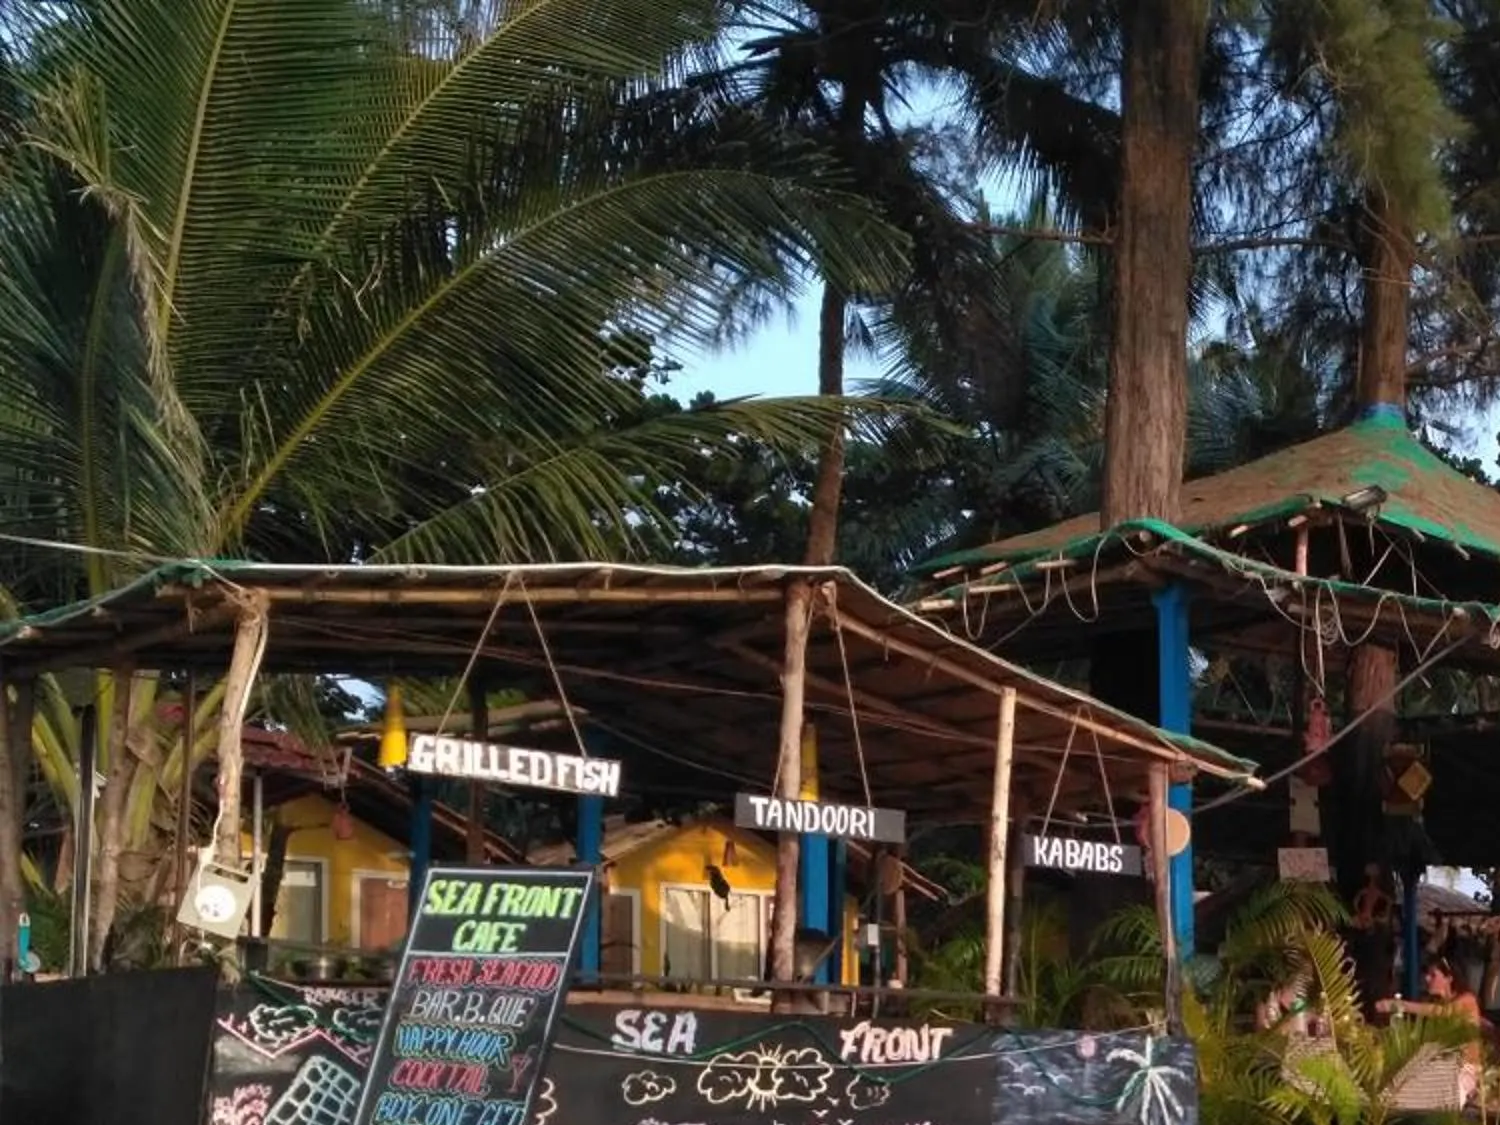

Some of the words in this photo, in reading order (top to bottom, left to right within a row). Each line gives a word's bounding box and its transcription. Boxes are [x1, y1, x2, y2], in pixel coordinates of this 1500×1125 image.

[408, 735, 552, 786] GRILLED
[556, 754, 621, 796] FISH
[748, 796, 875, 838] TANDOORI
[1033, 836, 1123, 873] KABABS
[422, 879, 483, 915] SEA
[480, 882, 583, 919] FRONT
[452, 919, 528, 952] CAFE
[408, 958, 474, 986] FRESH
[398, 1024, 458, 1053] HAPPY
[458, 1029, 510, 1066] HOUR
[612, 1008, 697, 1054] SEA
[840, 1020, 953, 1063] FRONT
[375, 1095, 422, 1124] BUY
